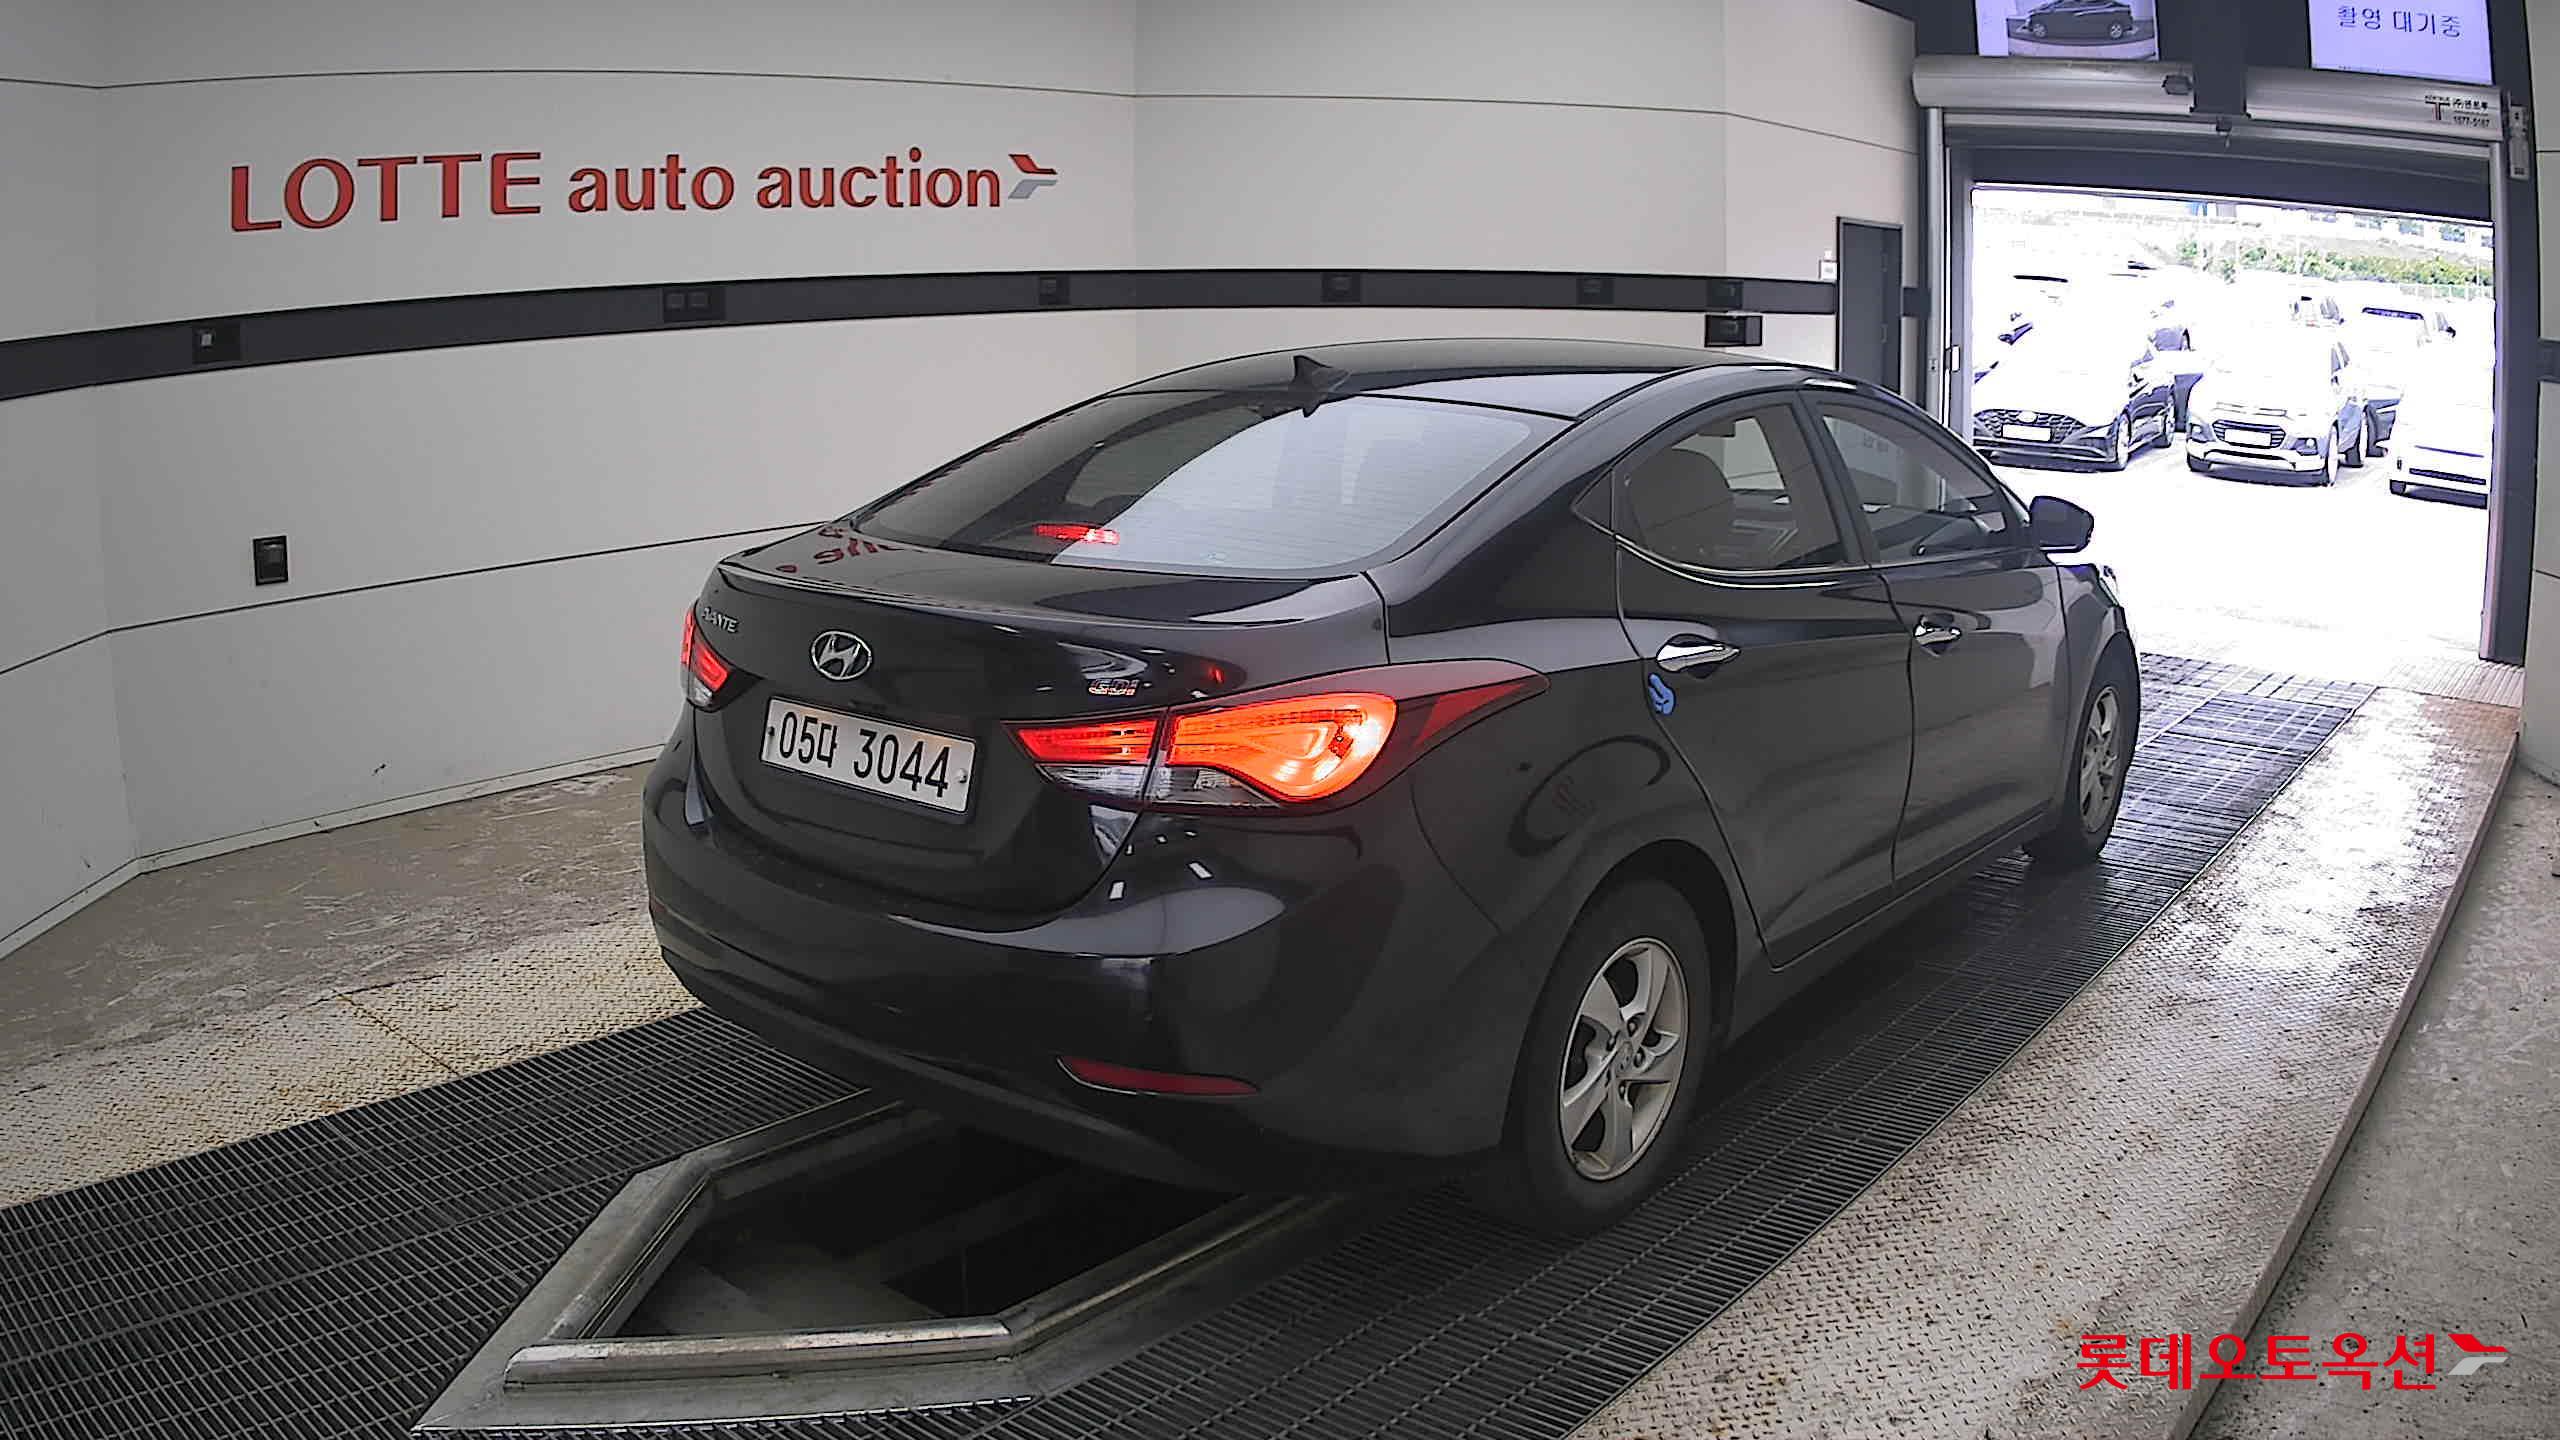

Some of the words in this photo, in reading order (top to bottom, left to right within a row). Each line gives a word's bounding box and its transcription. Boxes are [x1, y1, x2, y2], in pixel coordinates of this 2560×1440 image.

[2338, 5, 2382, 31] 촬영
[2392, 10, 2462, 38] 대기중
[231, 151, 542, 232] LOTTE
[567, 152, 735, 213] auto
[756, 146, 1002, 210] auction
[778, 711, 838, 769] 05다
[853, 728, 949, 799] 3044
